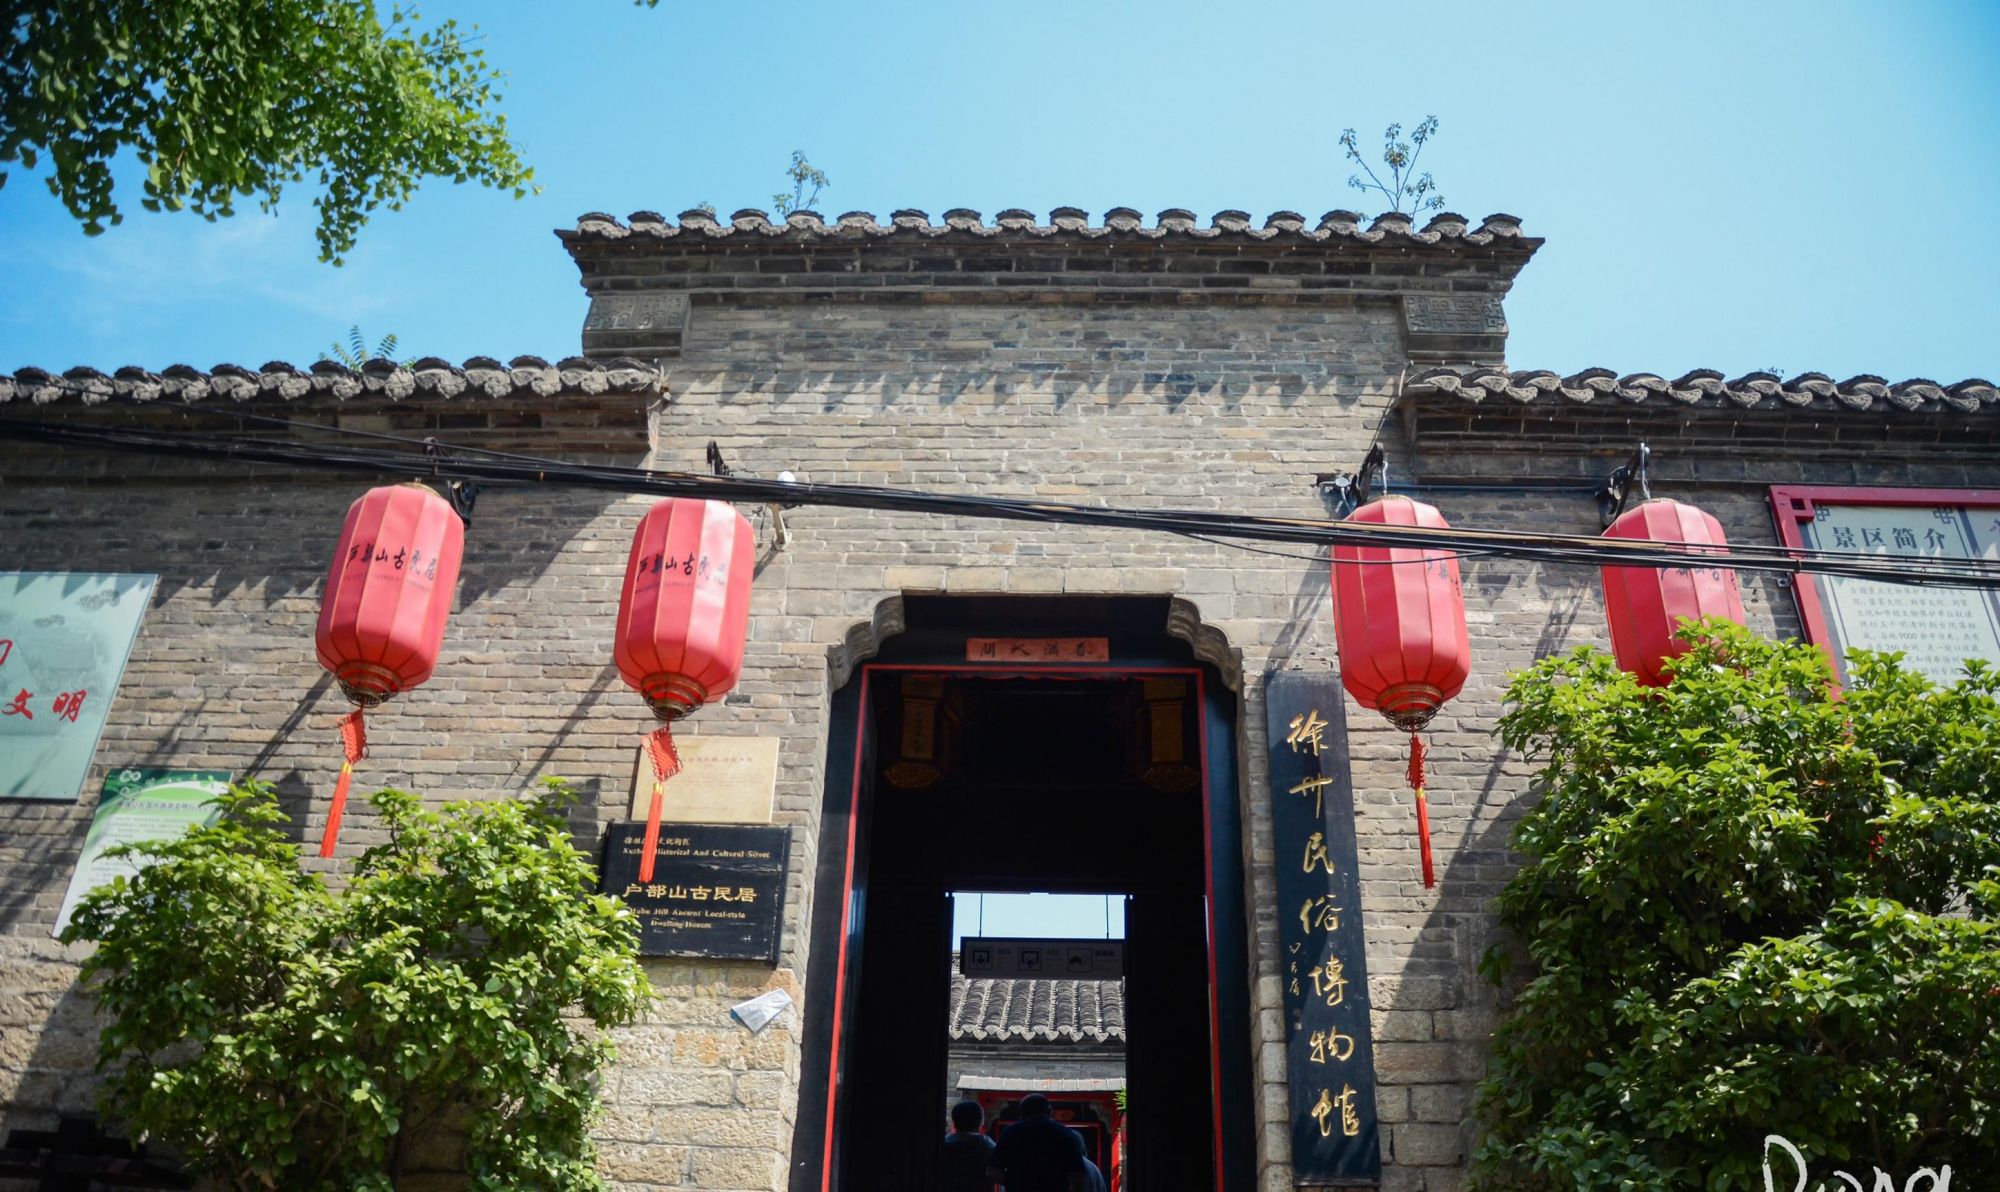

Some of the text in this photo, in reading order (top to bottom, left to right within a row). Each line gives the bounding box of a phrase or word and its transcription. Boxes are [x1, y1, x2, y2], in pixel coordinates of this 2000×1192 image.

[1832, 526, 1946, 550] 景区简介
[712, 849, 745, 858] Cultural
[622, 883, 758, 903] 户部山古民居
